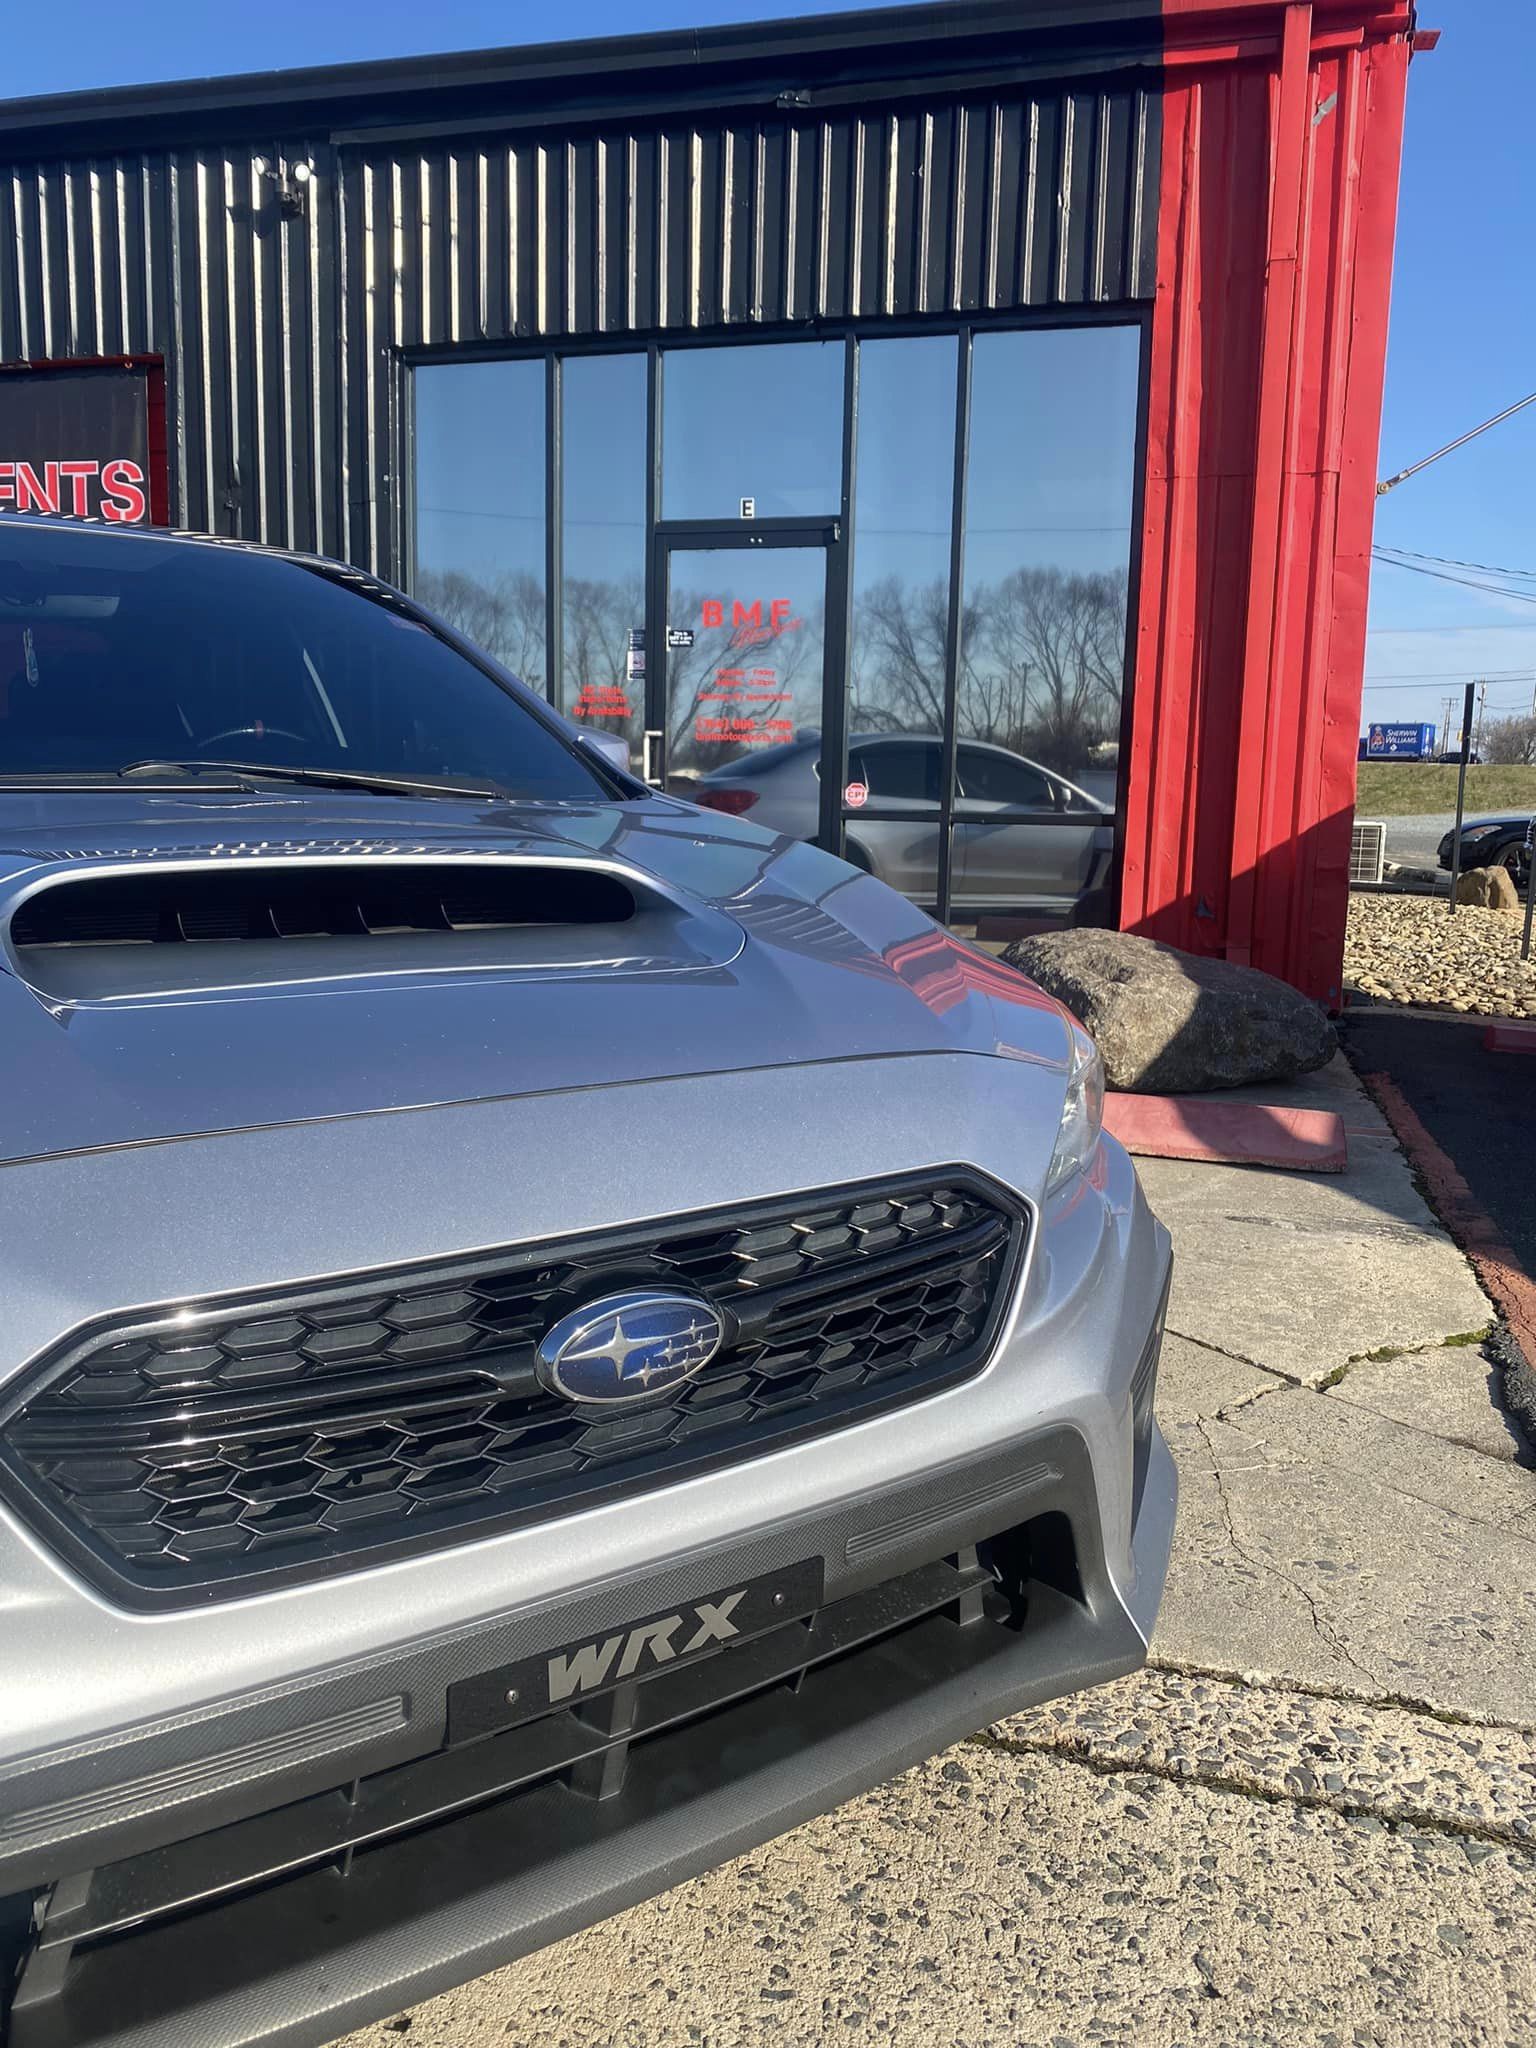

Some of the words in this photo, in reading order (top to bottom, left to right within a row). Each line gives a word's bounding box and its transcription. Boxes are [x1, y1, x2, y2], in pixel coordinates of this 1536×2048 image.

[742, 499, 753, 517] E
[1387, 729, 1417, 737] SHERWIN
[1385, 736, 1417, 744] WILLIAMS
[548, 1590, 748, 1703] WRX
